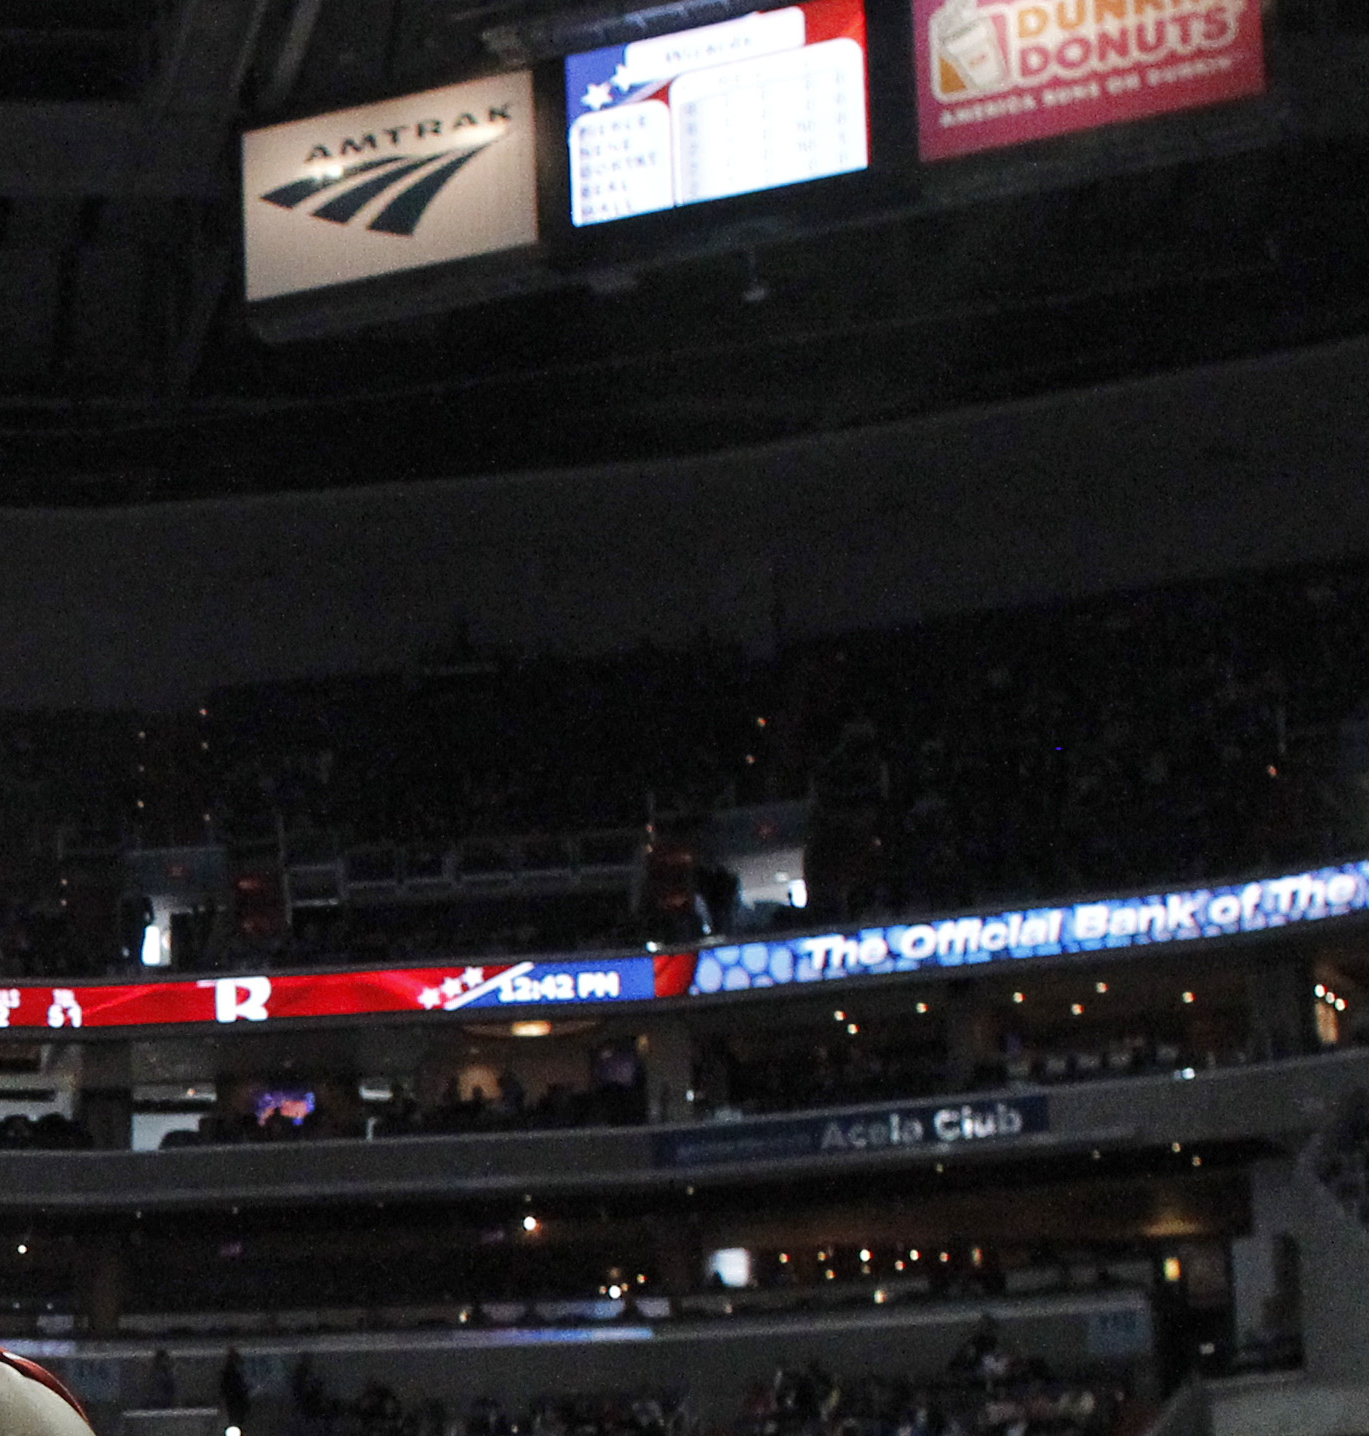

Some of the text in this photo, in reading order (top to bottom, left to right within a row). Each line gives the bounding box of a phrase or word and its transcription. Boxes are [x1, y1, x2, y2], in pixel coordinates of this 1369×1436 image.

[1019, 8, 1230, 78] DONUTS
[304, 104, 513, 163] AMTRAK
[803, 934, 888, 970] The
[900, 908, 1063, 959] Official
[1074, 894, 1197, 940] Bank
[1209, 883, 1262, 925] of
[577, 971, 620, 998] PM
[933, 1102, 1023, 1141] Club
